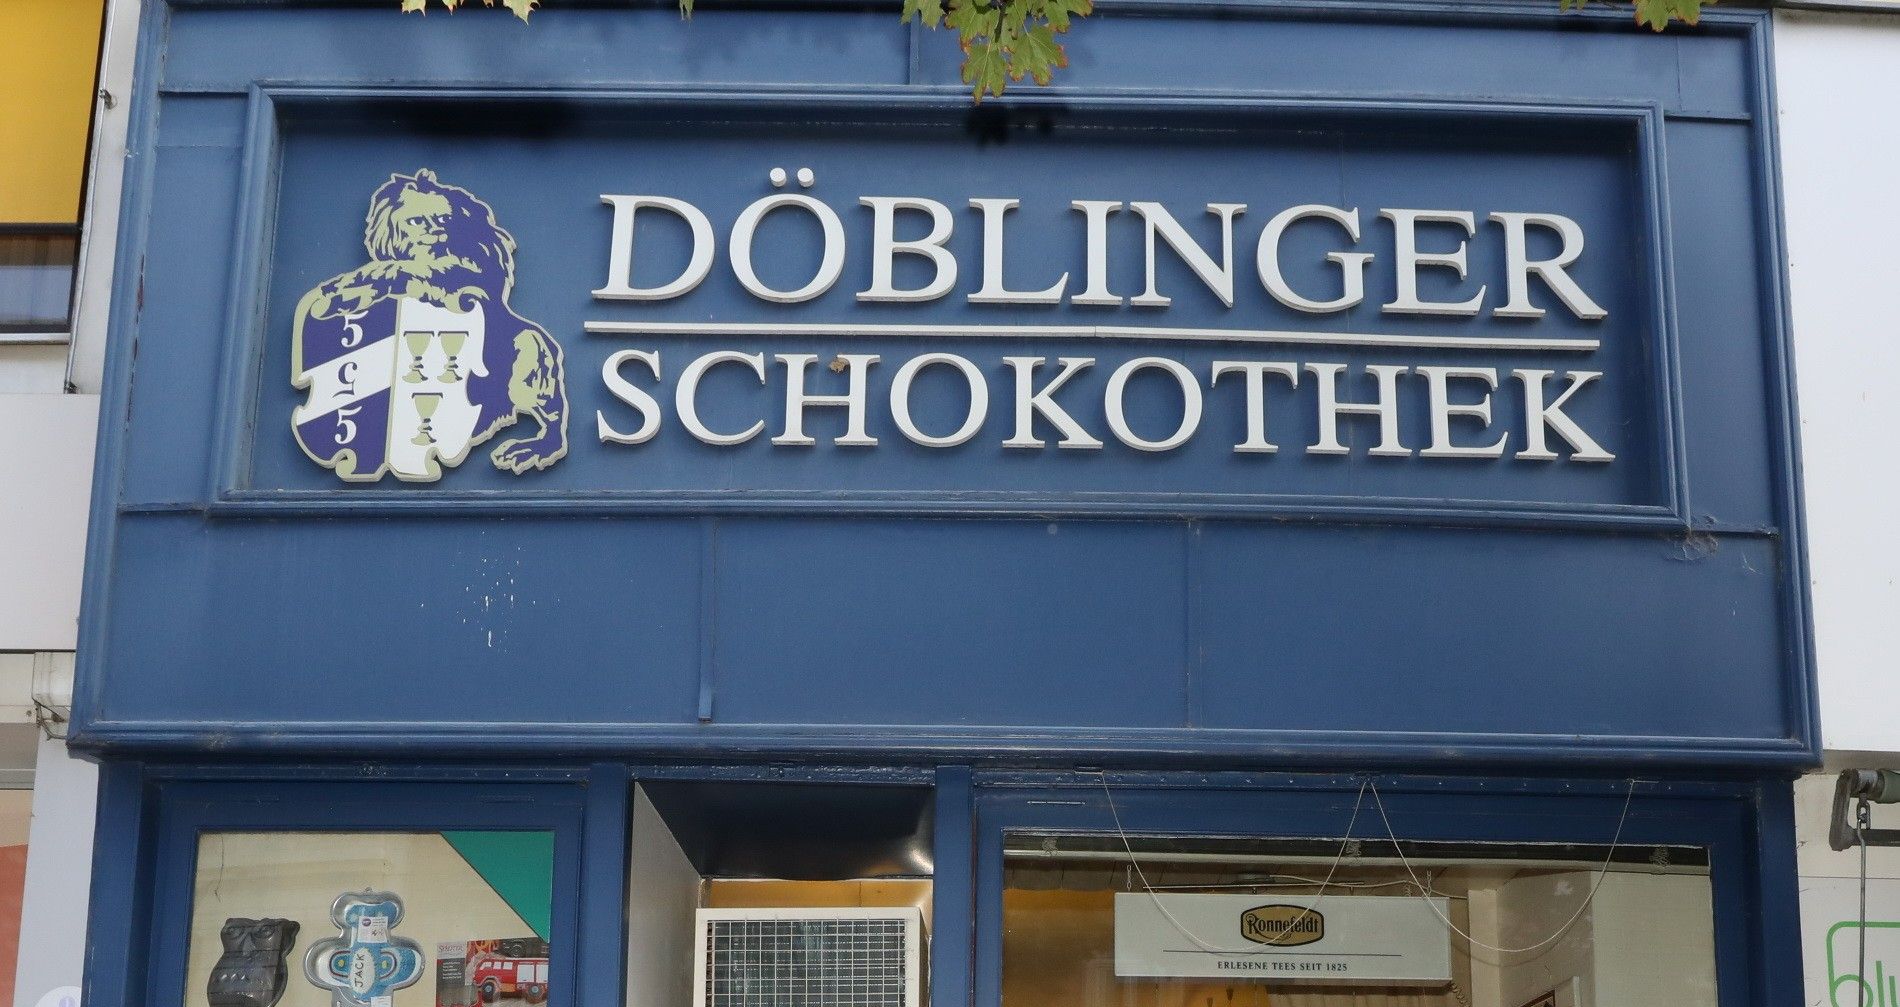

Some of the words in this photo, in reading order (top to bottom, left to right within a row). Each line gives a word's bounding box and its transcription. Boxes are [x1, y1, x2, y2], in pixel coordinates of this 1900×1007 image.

[592, 167, 1608, 320] DÖBLINGER
[596, 350, 1616, 463] SCHOKOTHEK
[1245, 913, 1319, 938] Ronnefeldt
[354, 953, 366, 989] JACK
[1217, 961, 1268, 971] ERLESENE
[1272, 962, 1298, 972] TEES
[1299, 963, 1323, 972] SEIT
